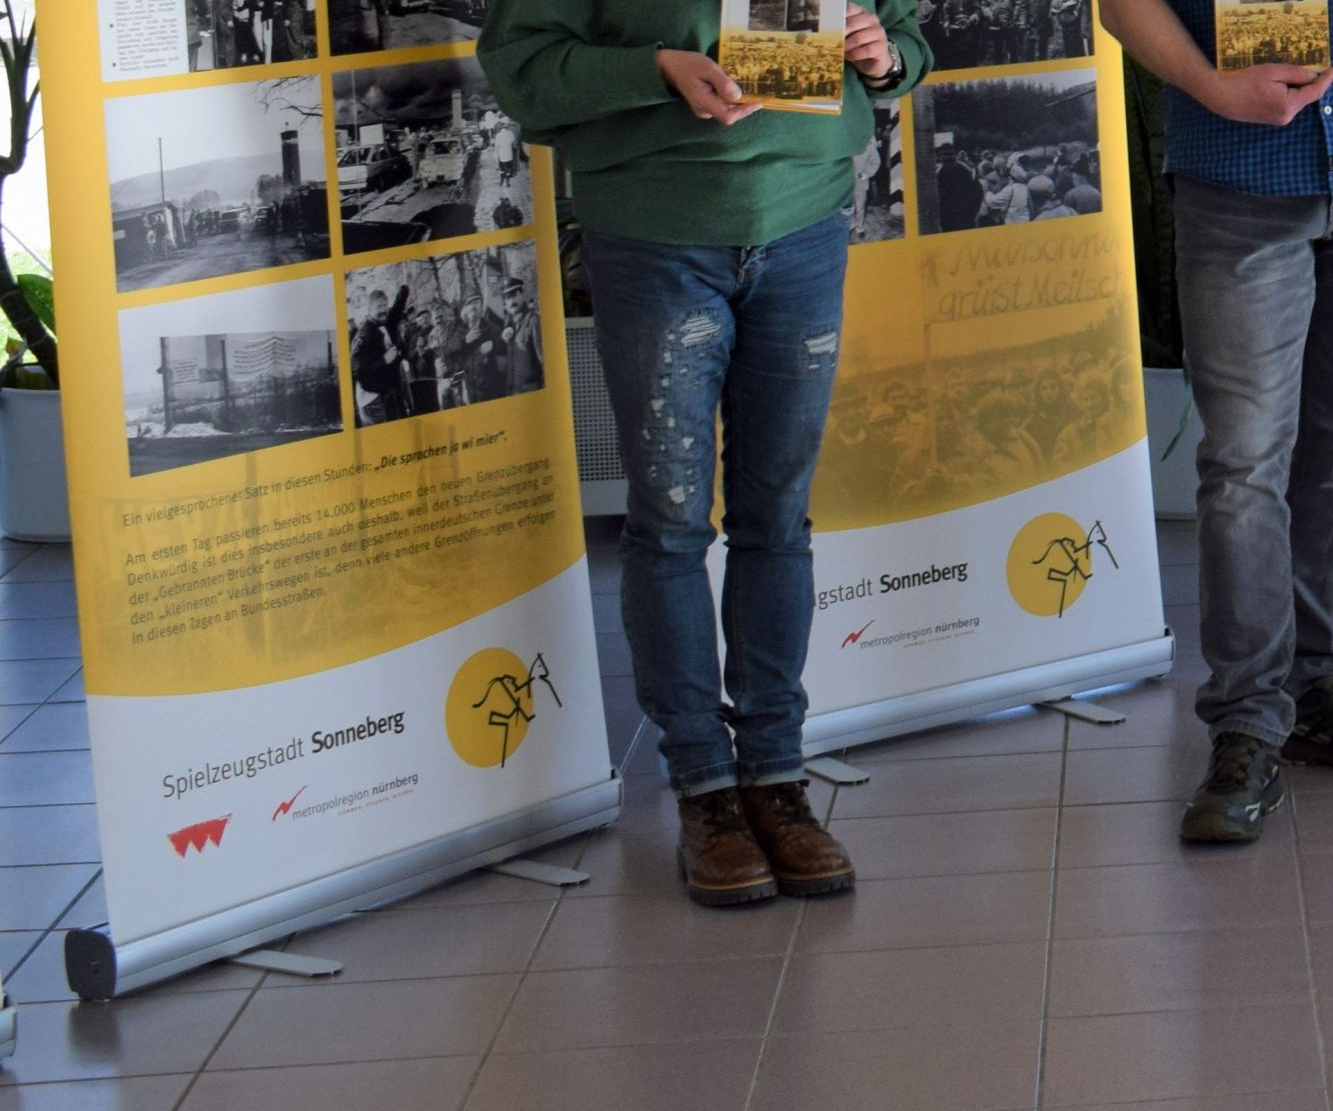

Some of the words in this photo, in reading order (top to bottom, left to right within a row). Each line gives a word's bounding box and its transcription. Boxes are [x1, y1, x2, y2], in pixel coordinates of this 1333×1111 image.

[878, 561, 969, 594] Sonneberg
[162, 736, 305, 798] Spielzeugstadt
[310, 710, 406, 754] Sonneberg
